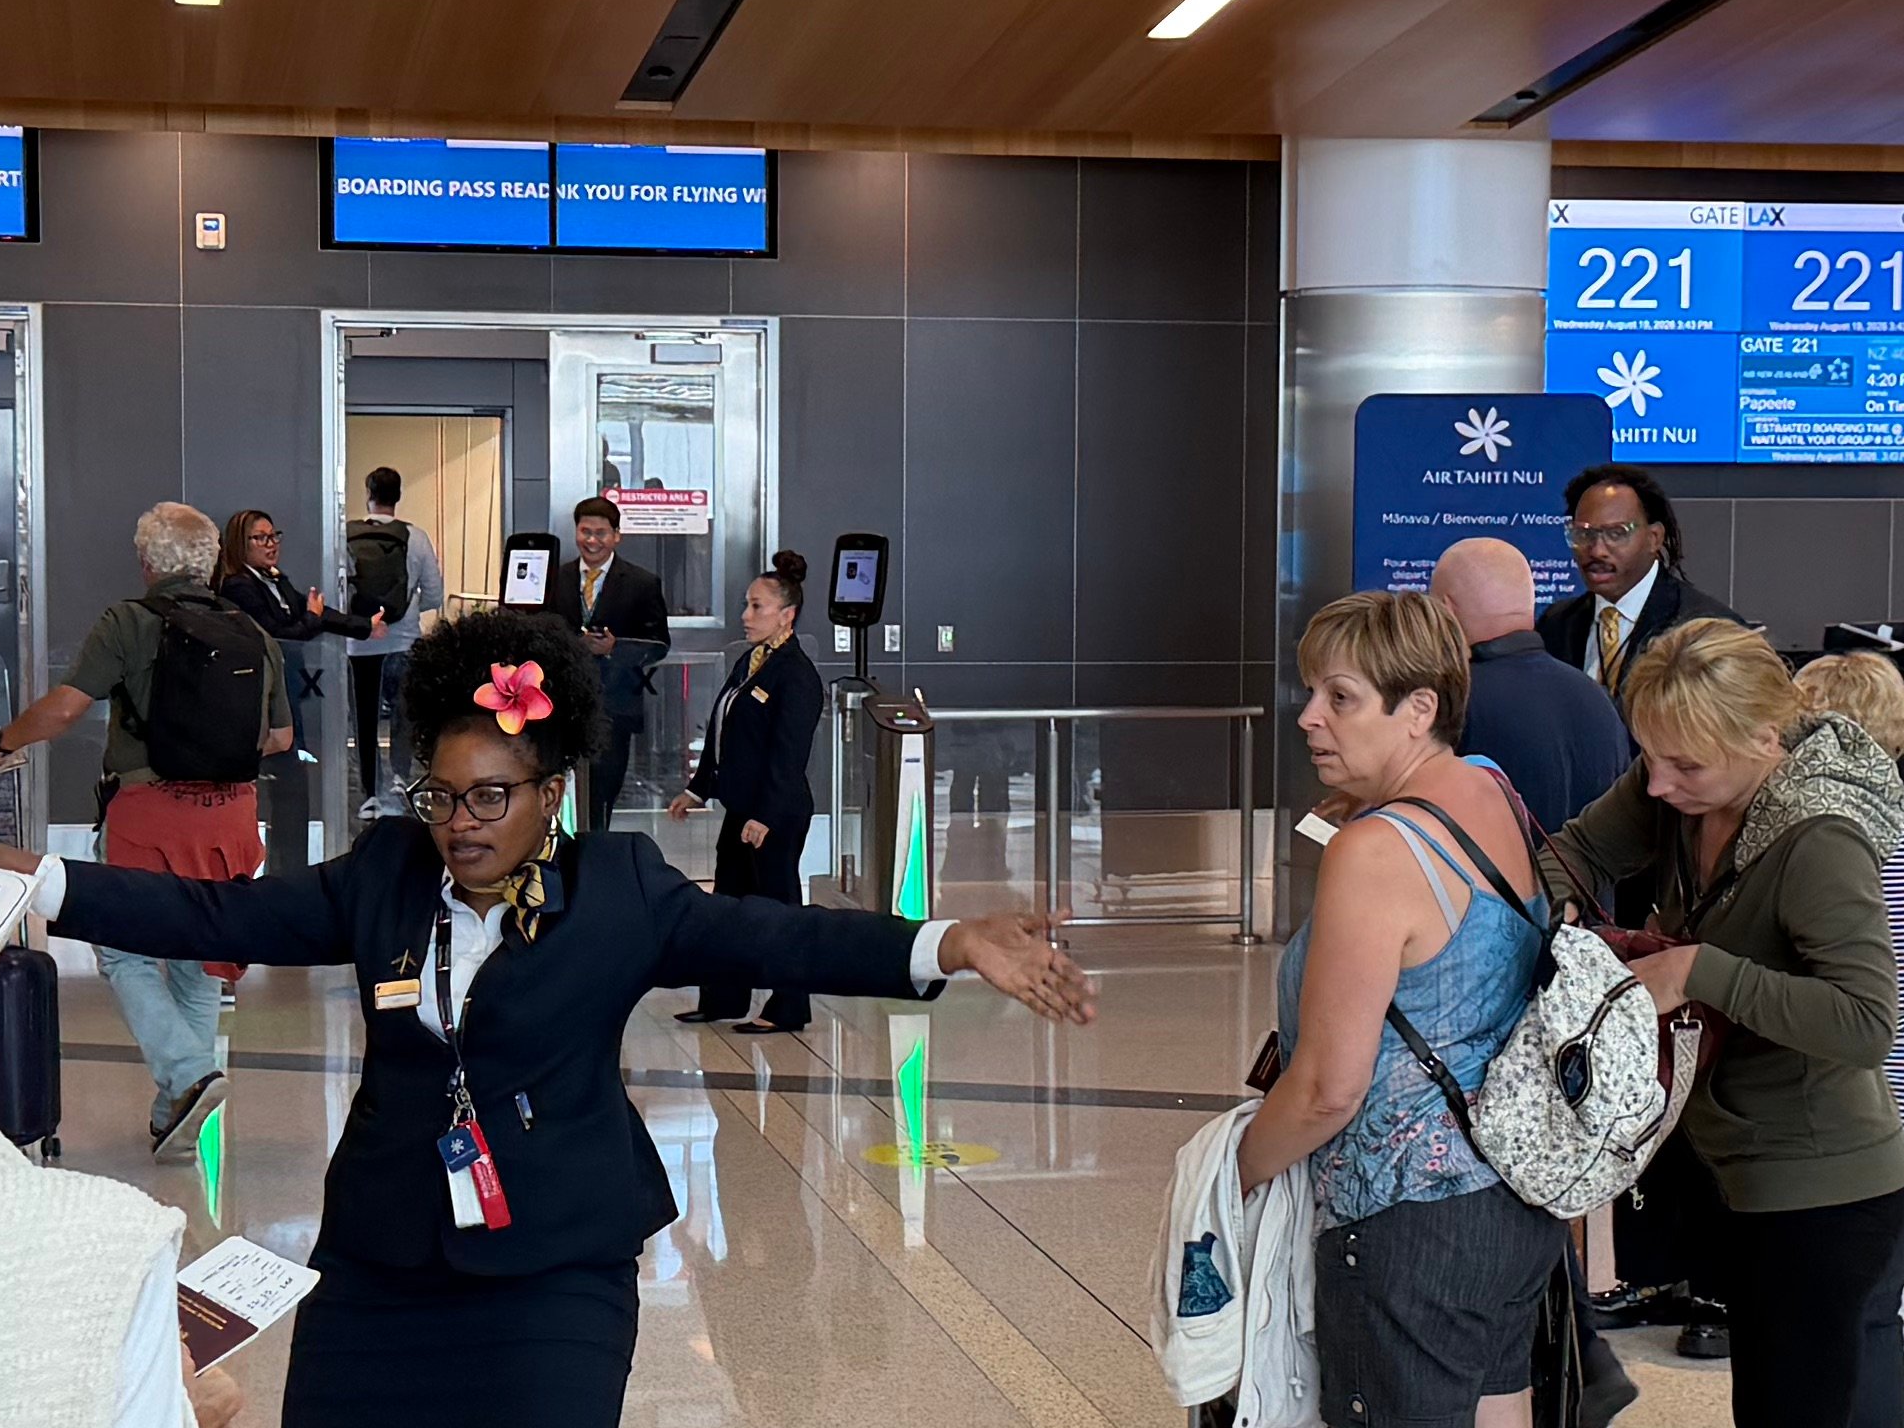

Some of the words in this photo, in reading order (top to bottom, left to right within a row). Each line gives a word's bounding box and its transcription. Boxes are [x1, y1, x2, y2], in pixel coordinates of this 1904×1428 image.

[337, 178, 443, 197] BOARDING
[448, 181, 496, 198] PASS
[584, 184, 625, 201] YOU
[630, 185, 668, 202] FOR
[672, 186, 738, 203] FLYING
[1689, 206, 1739, 225] GATE
[1748, 207, 1786, 227] LAX
[1576, 247, 1692, 310] 221
[1791, 250, 1904, 312] 221
[1553, 319, 1605, 331] Wednesday
[1607, 320, 1638, 332] August
[1697, 321, 1714, 331] PM
[1768, 321, 1818, 332] Wednesday
[1820, 322, 1850, 333] August
[1740, 337, 1784, 353] GATE
[1791, 337, 1818, 353] 221
[1867, 347, 1888, 361] NZ
[1739, 396, 1797, 412] Papeete
[1865, 400, 1885, 413] On
[1663, 427, 1697, 444] NUI
[1867, 423, 1890, 434] TIME
[1806, 435, 1836, 445] YOUR
[1837, 435, 1874, 445] GROUP
[1422, 470, 1454, 485] AIR
[1454, 470, 1509, 485] TAHITI
[1512, 470, 1544, 485] NUI
[621, 492, 668, 503] RESTRICTED
[1442, 512, 1508, 525] Bienvenue
[1521, 512, 1573, 525] Welcom
[1383, 557, 1408, 568] Pour
[1552, 572, 1571, 583] par
[1559, 584, 1576, 593] sur
